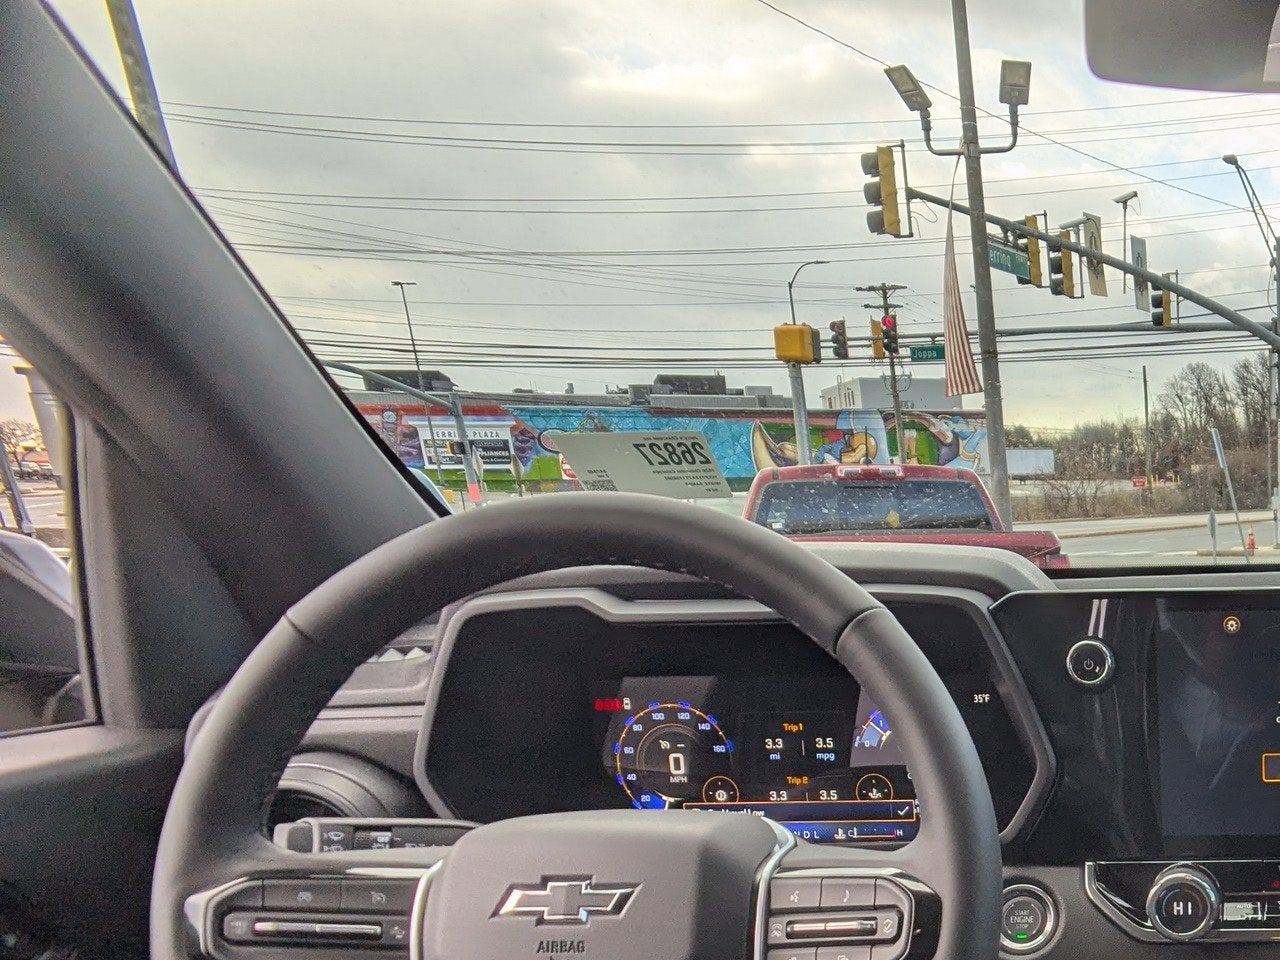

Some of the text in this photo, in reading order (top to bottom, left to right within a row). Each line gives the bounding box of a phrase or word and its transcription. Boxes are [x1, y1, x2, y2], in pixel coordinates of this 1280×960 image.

[989, 249, 1012, 271] erring
[913, 349, 937, 359] Joppa
[651, 712, 665, 721] 100
[677, 712, 691, 721] 120
[632, 723, 643, 732] 80
[697, 722, 711, 731] 140
[782, 722, 798, 733] Trip
[765, 738, 784, 750] 3.3
[815, 737, 834, 749] 3.5
[623, 746, 634, 755] 60
[712, 744, 726, 753] 160
[769, 751, 781, 761] mi
[816, 752, 835, 761] mpg
[668, 752, 686, 775] 0
[626, 773, 637, 782] 40
[669, 776, 688, 784] MPH
[786, 776, 802, 786] Trip
[640, 794, 652, 802] 20
[769, 789, 788, 802] 3.3
[819, 789, 838, 801] 3.5
[1173, 901, 1193, 916] HI
[1010, 915, 1035, 923] ENGINE
[536, 940, 586, 954] AIRBAG
